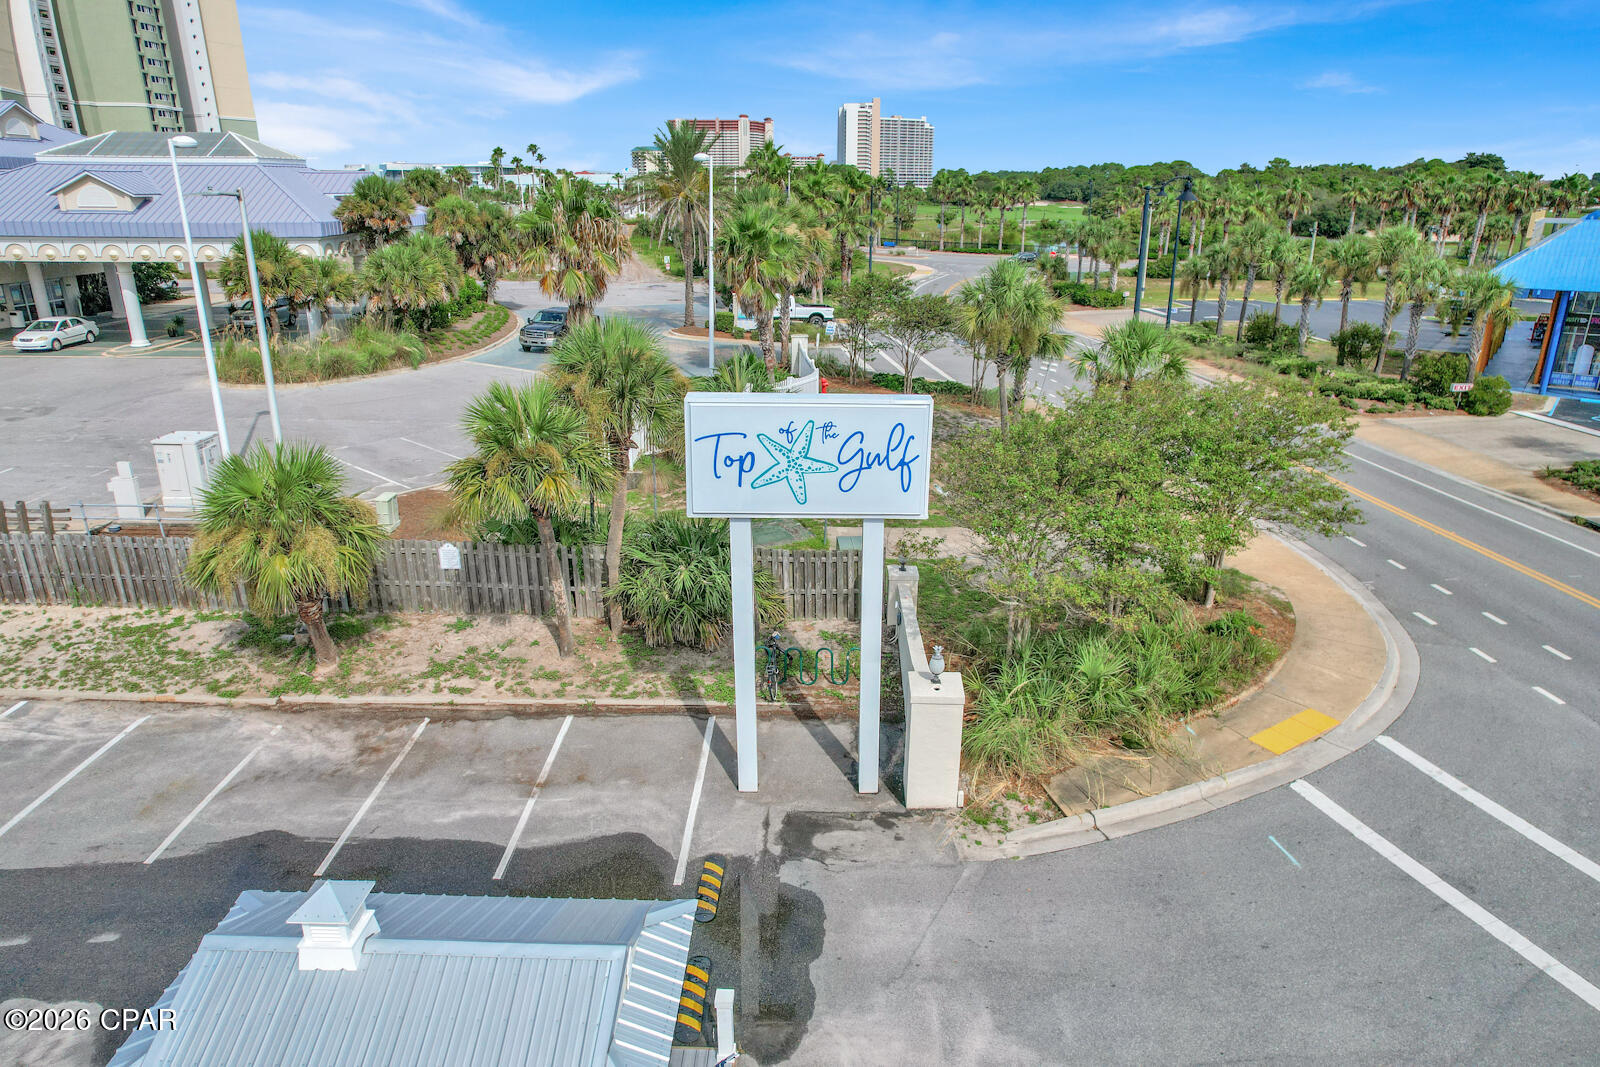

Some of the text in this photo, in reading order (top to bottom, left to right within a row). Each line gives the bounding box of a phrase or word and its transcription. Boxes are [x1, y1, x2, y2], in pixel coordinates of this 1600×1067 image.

[694, 420, 920, 493] Top of the Gulf
